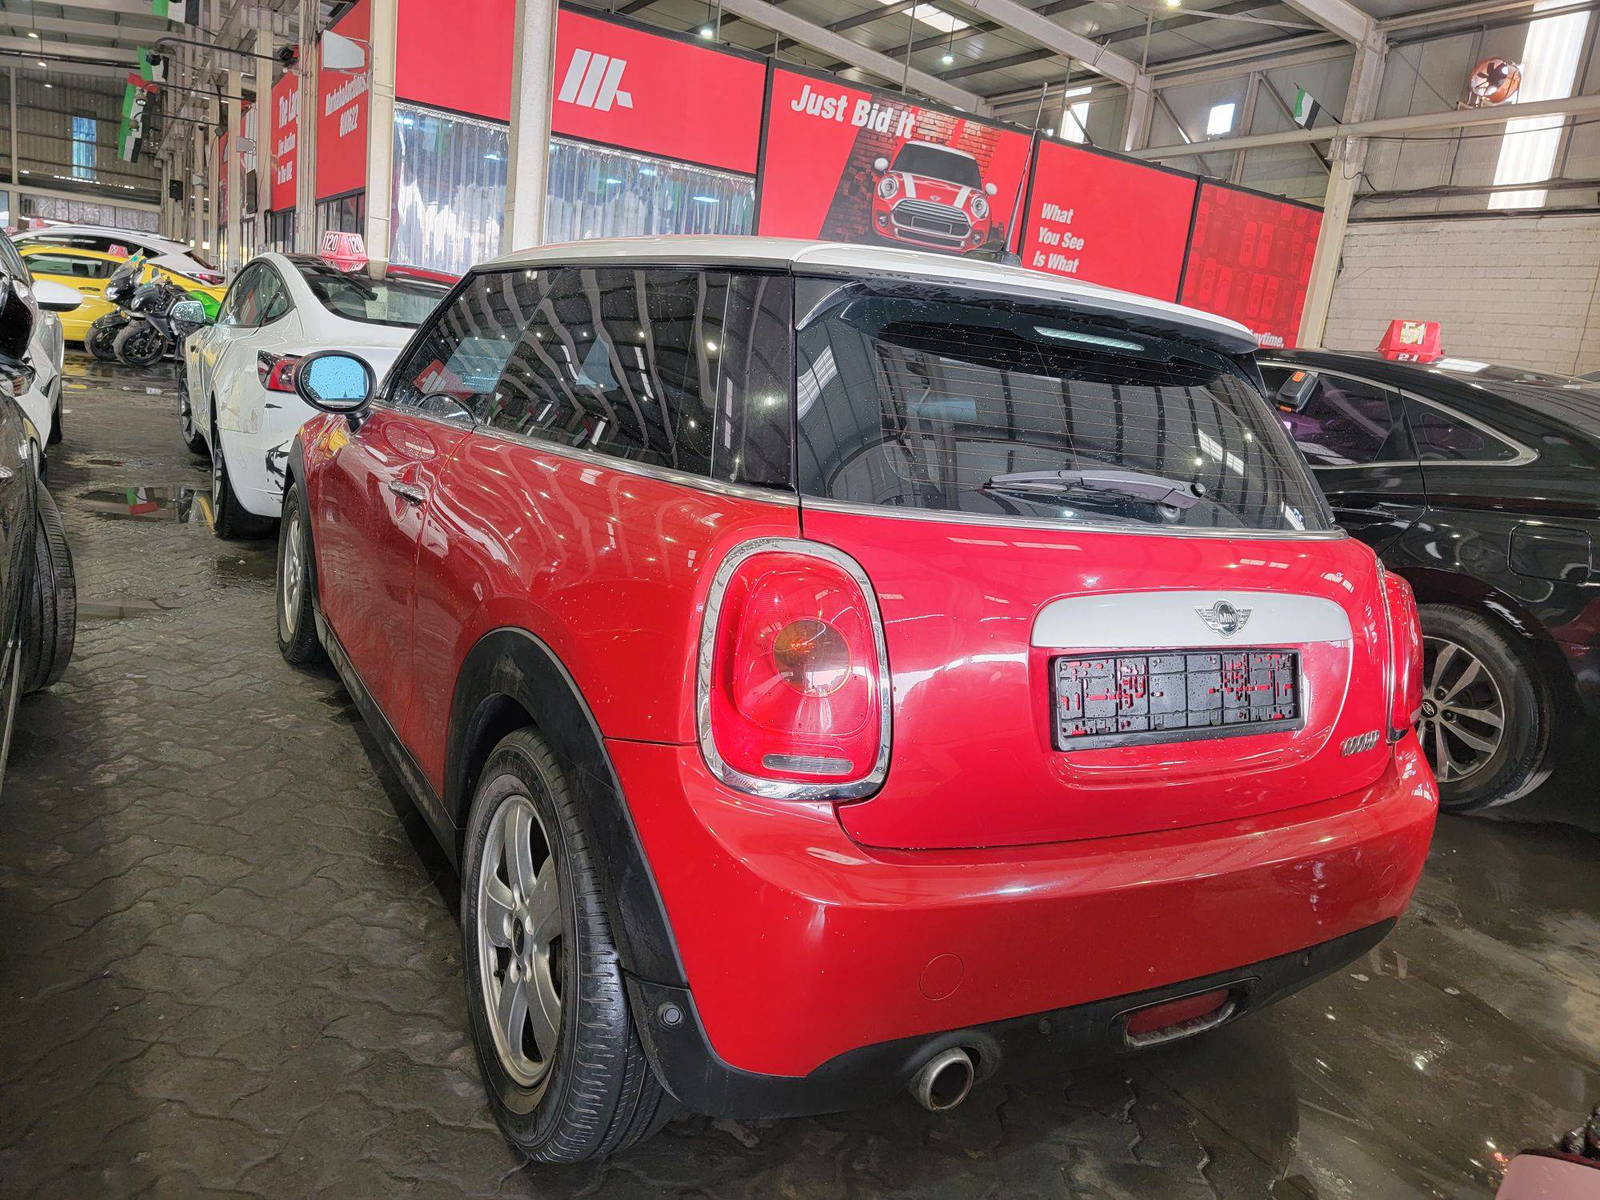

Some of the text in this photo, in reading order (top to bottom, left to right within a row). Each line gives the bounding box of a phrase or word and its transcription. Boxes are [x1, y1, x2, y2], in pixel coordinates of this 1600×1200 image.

[791, 84, 916, 139] Just Bid It
[1041, 202, 1074, 225] What
[324, 233, 339, 251] 120
[1038, 226, 1085, 251] You See
[1032, 250, 1080, 274] Is What
